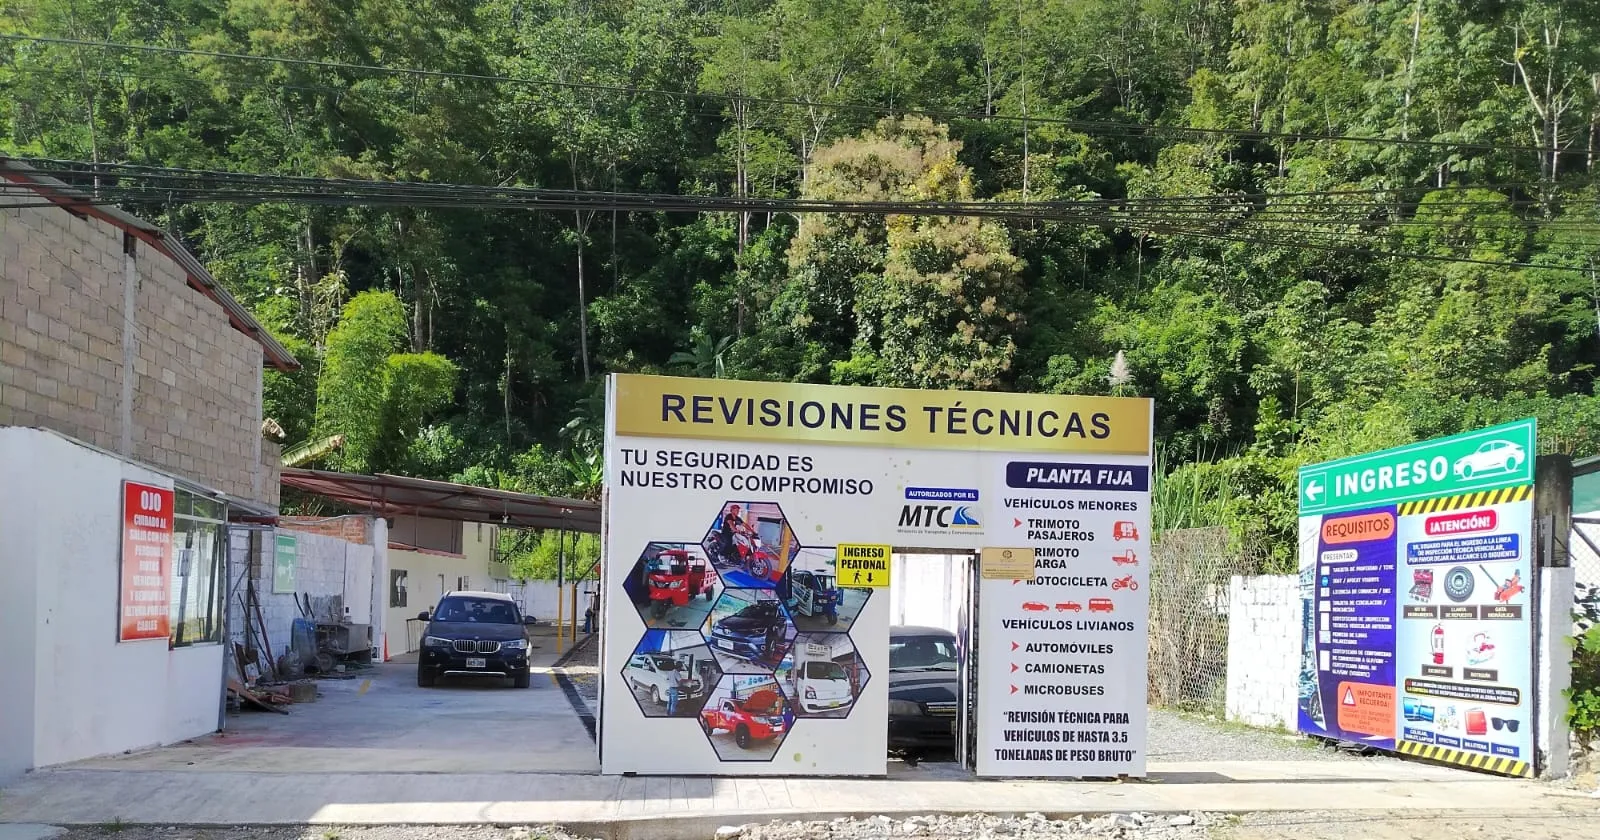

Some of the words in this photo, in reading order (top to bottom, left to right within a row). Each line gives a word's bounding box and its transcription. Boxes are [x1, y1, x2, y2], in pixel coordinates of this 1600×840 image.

[662, 394, 907, 432] REVISIONES
[923, 401, 1111, 439] TÉCNICAS
[621, 449, 648, 465] TU
[656, 450, 780, 471] SEGURIDAD
[787, 456, 813, 472] ES
[621, 470, 723, 491] NUESTRO
[730, 474, 873, 495] COMPROMISO
[1026, 467, 1092, 485] PLANTA
[1097, 470, 1133, 486] FIJA
[1335, 456, 1449, 497] INGRESO
[908, 490, 952, 498] AUTORIZADOS
[141, 490, 161, 512] OJO
[1004, 496, 1074, 510] VEHÍCULOS
[1078, 500, 1138, 512] MENORES
[898, 505, 952, 528] MTC
[1027, 518, 1080, 529] TRIMOTO
[1326, 518, 1390, 537] REQUISITOS
[1430, 515, 1491, 533] ¡ATENCIÓN!
[1027, 530, 1095, 541] PASAJEROS
[844, 547, 884, 558] INGRESO
[1034, 547, 1080, 558] RIMOTO
[841, 559, 886, 570] PEATONAL
[1034, 559, 1067, 568] ARGA
[1026, 576, 1108, 587] MOTOCICLETA
[1002, 618, 1073, 630] VEHÍCULOS
[1076, 620, 1134, 631] LIVIANOS
[1025, 641, 1113, 654] AUTOMÓVILES
[1024, 663, 1105, 674] CAMIONETAS
[1024, 684, 1105, 696] MICROBUSES
[1058, 710, 1100, 724] TÉCNICA
[1103, 712, 1129, 724] PARA
[1004, 728, 1060, 742] VEHÍCULOS
[1062, 731, 1075, 742] DE
[1077, 731, 1110, 743] HASTA
[1111, 732, 1128, 743] 3.5
[994, 749, 1053, 761] TONELADAS
[1055, 749, 1068, 761] DE
[1070, 750, 1095, 762] PESO
